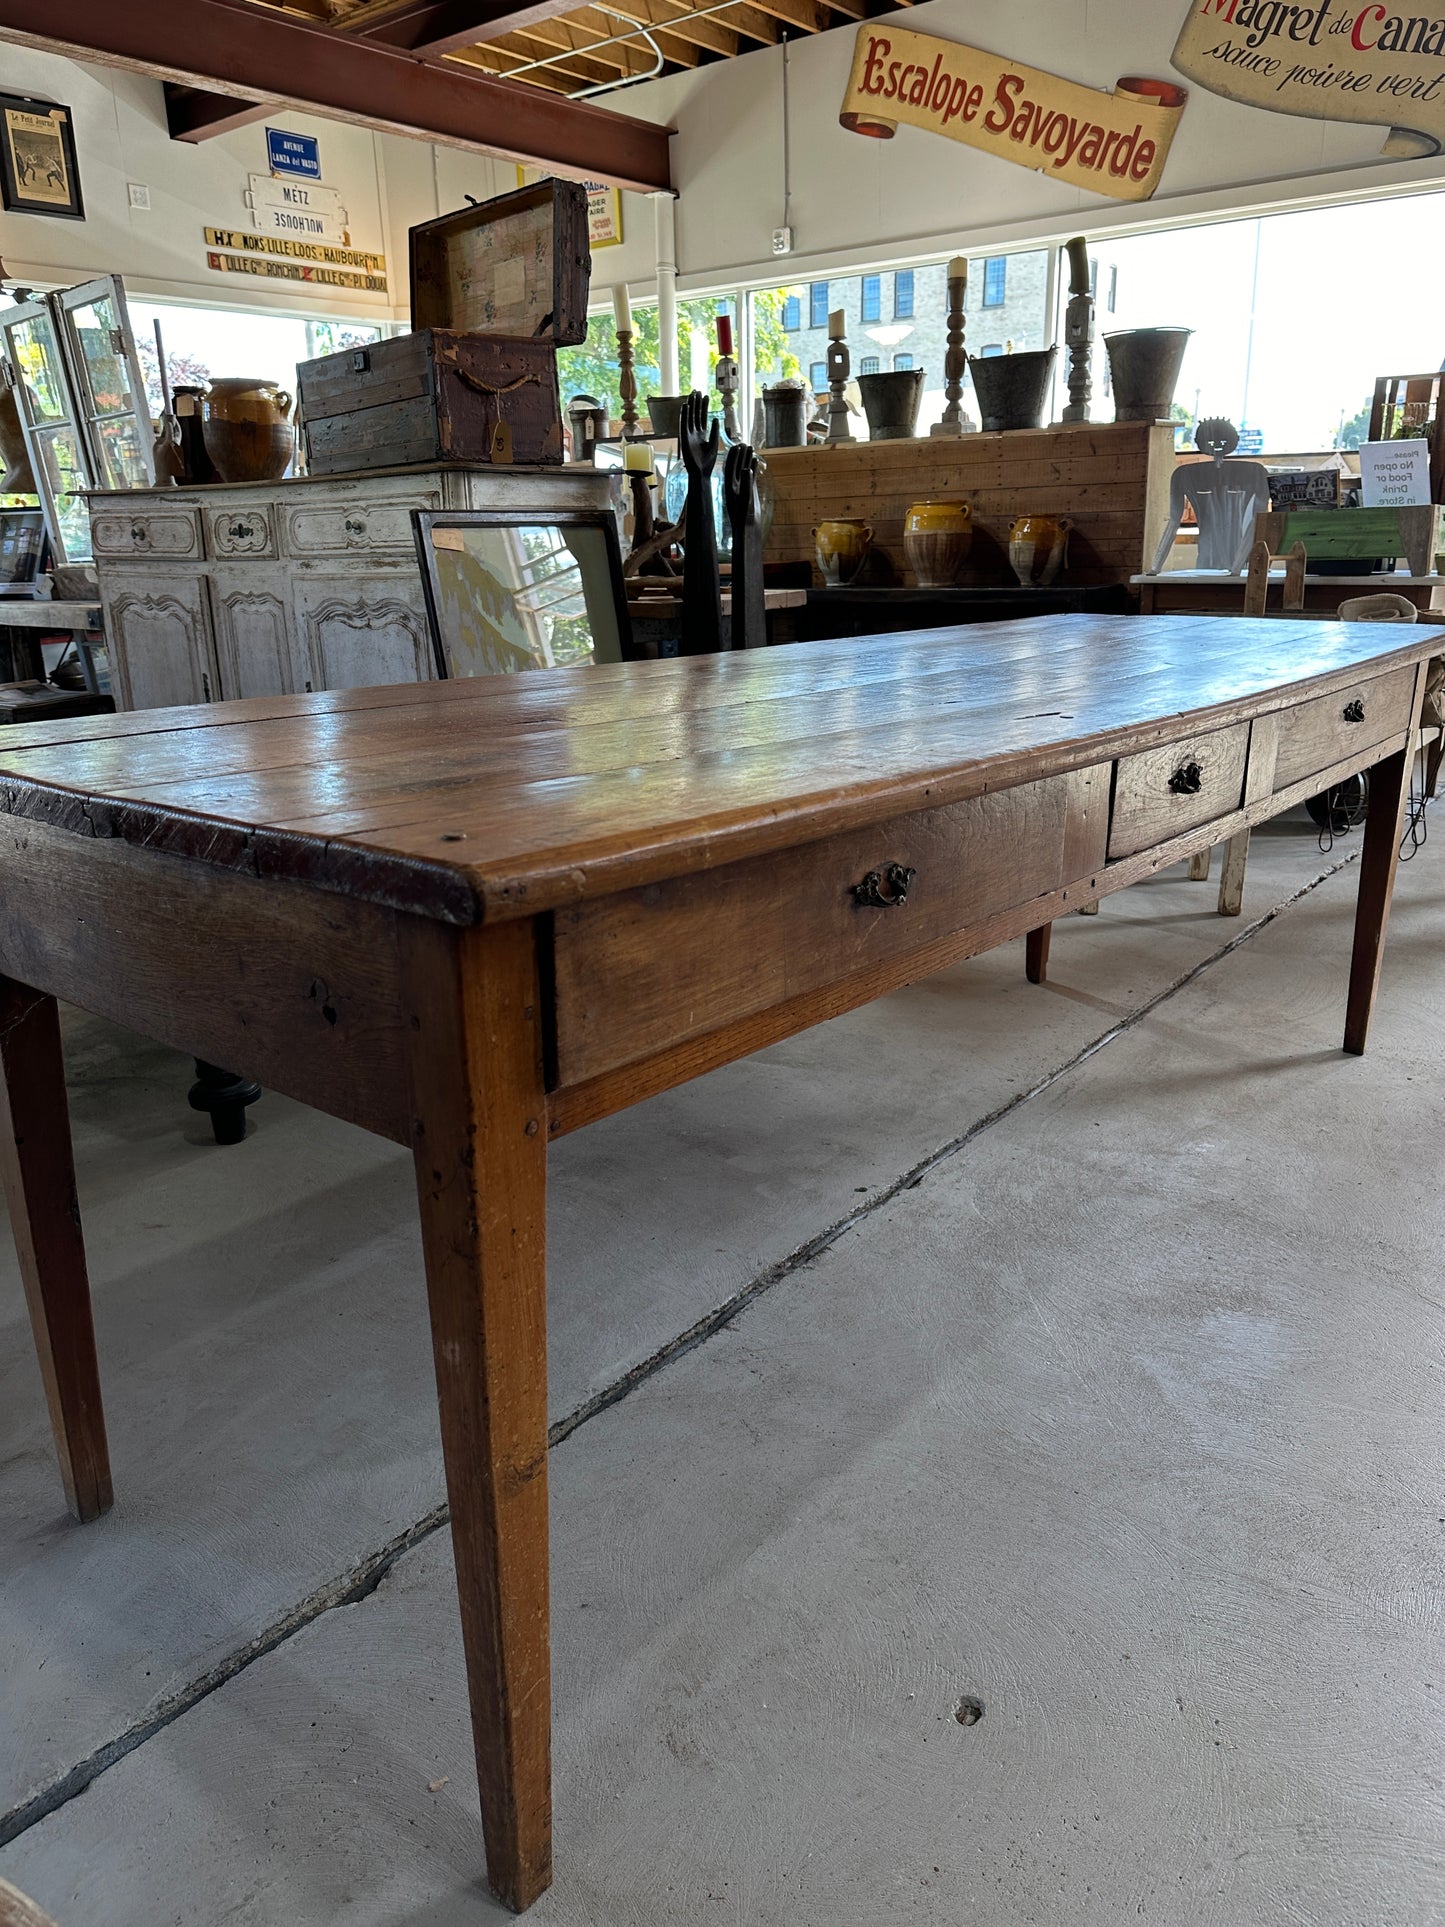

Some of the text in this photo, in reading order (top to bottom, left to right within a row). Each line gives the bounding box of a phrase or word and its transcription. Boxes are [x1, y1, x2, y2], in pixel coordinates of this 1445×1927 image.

[1328, 10, 1353, 35] de
[1202, 39, 1445, 101] sauce poivre vert
[858, 36, 1156, 181] Escalope Savoyarde
[283, 141, 304, 153] AVENUE
[272, 152, 290, 164] LANZA
[301, 158, 317, 170] VASTO
[283, 187, 310, 205] METZ
[274, 212, 323, 234] MULHOUSE
